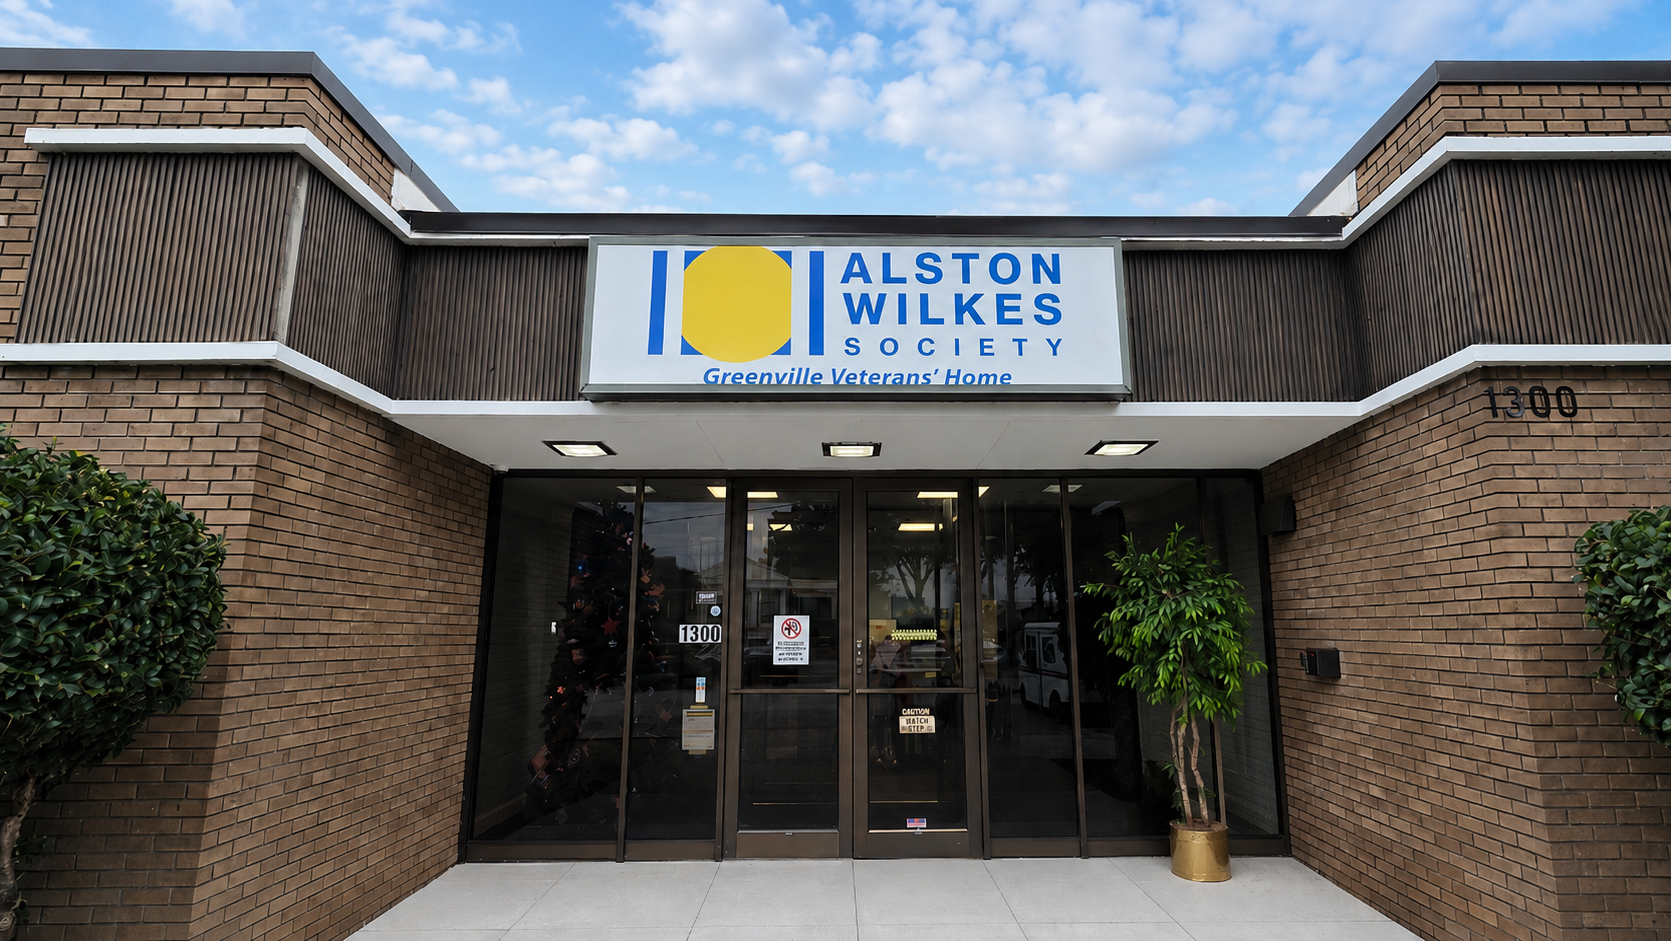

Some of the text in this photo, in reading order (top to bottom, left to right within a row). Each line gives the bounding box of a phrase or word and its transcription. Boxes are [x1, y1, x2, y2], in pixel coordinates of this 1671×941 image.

[840, 252, 1062, 286] ALSTON
[842, 292, 1063, 326] WILKES
[843, 336, 1064, 357] SOCIETY
[703, 367, 824, 386] Greenville
[944, 369, 1013, 386] Home
[1483, 385, 1578, 419] 1300
[681, 625, 720, 642] 1300
